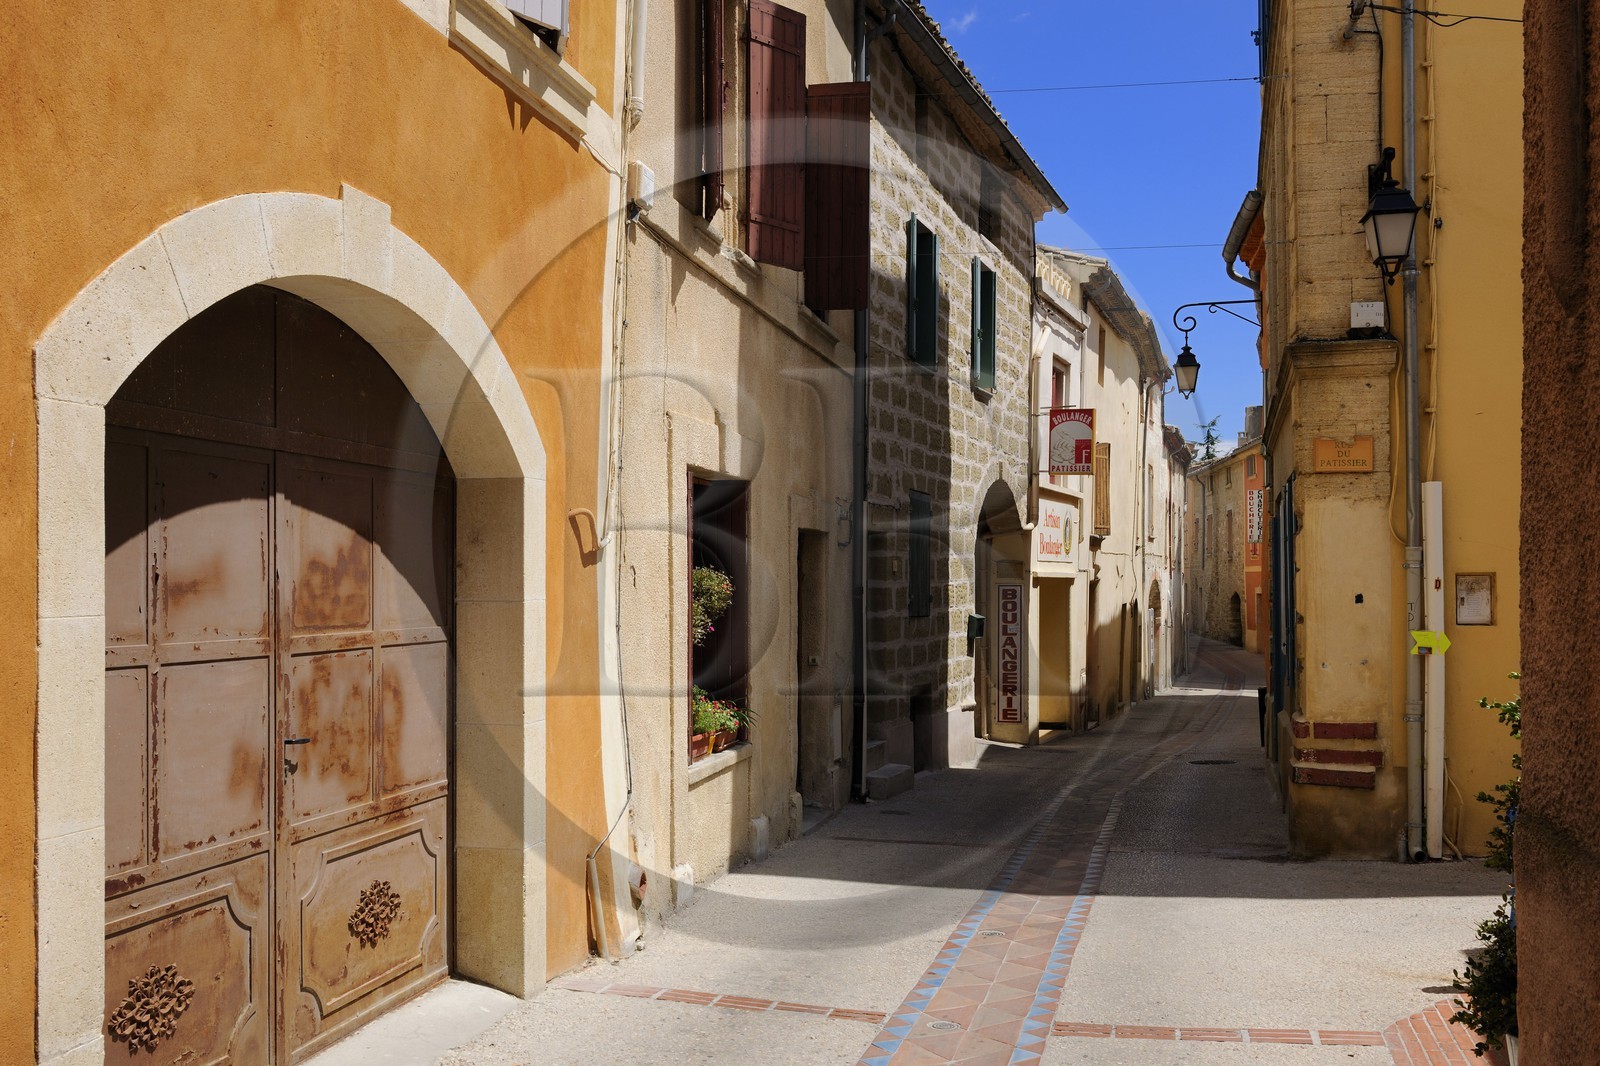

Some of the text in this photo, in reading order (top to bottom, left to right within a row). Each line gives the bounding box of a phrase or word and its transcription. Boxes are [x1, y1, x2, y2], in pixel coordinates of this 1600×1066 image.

[1052, 411, 1092, 425] BOULANGER
[1320, 459, 1368, 467] PATISSIER
[1337, 450, 1351, 458] DU
[1043, 506, 1061, 528] Artisan
[1040, 532, 1062, 557] Boulanger
[1002, 588, 1018, 720] BOULANGERIE
